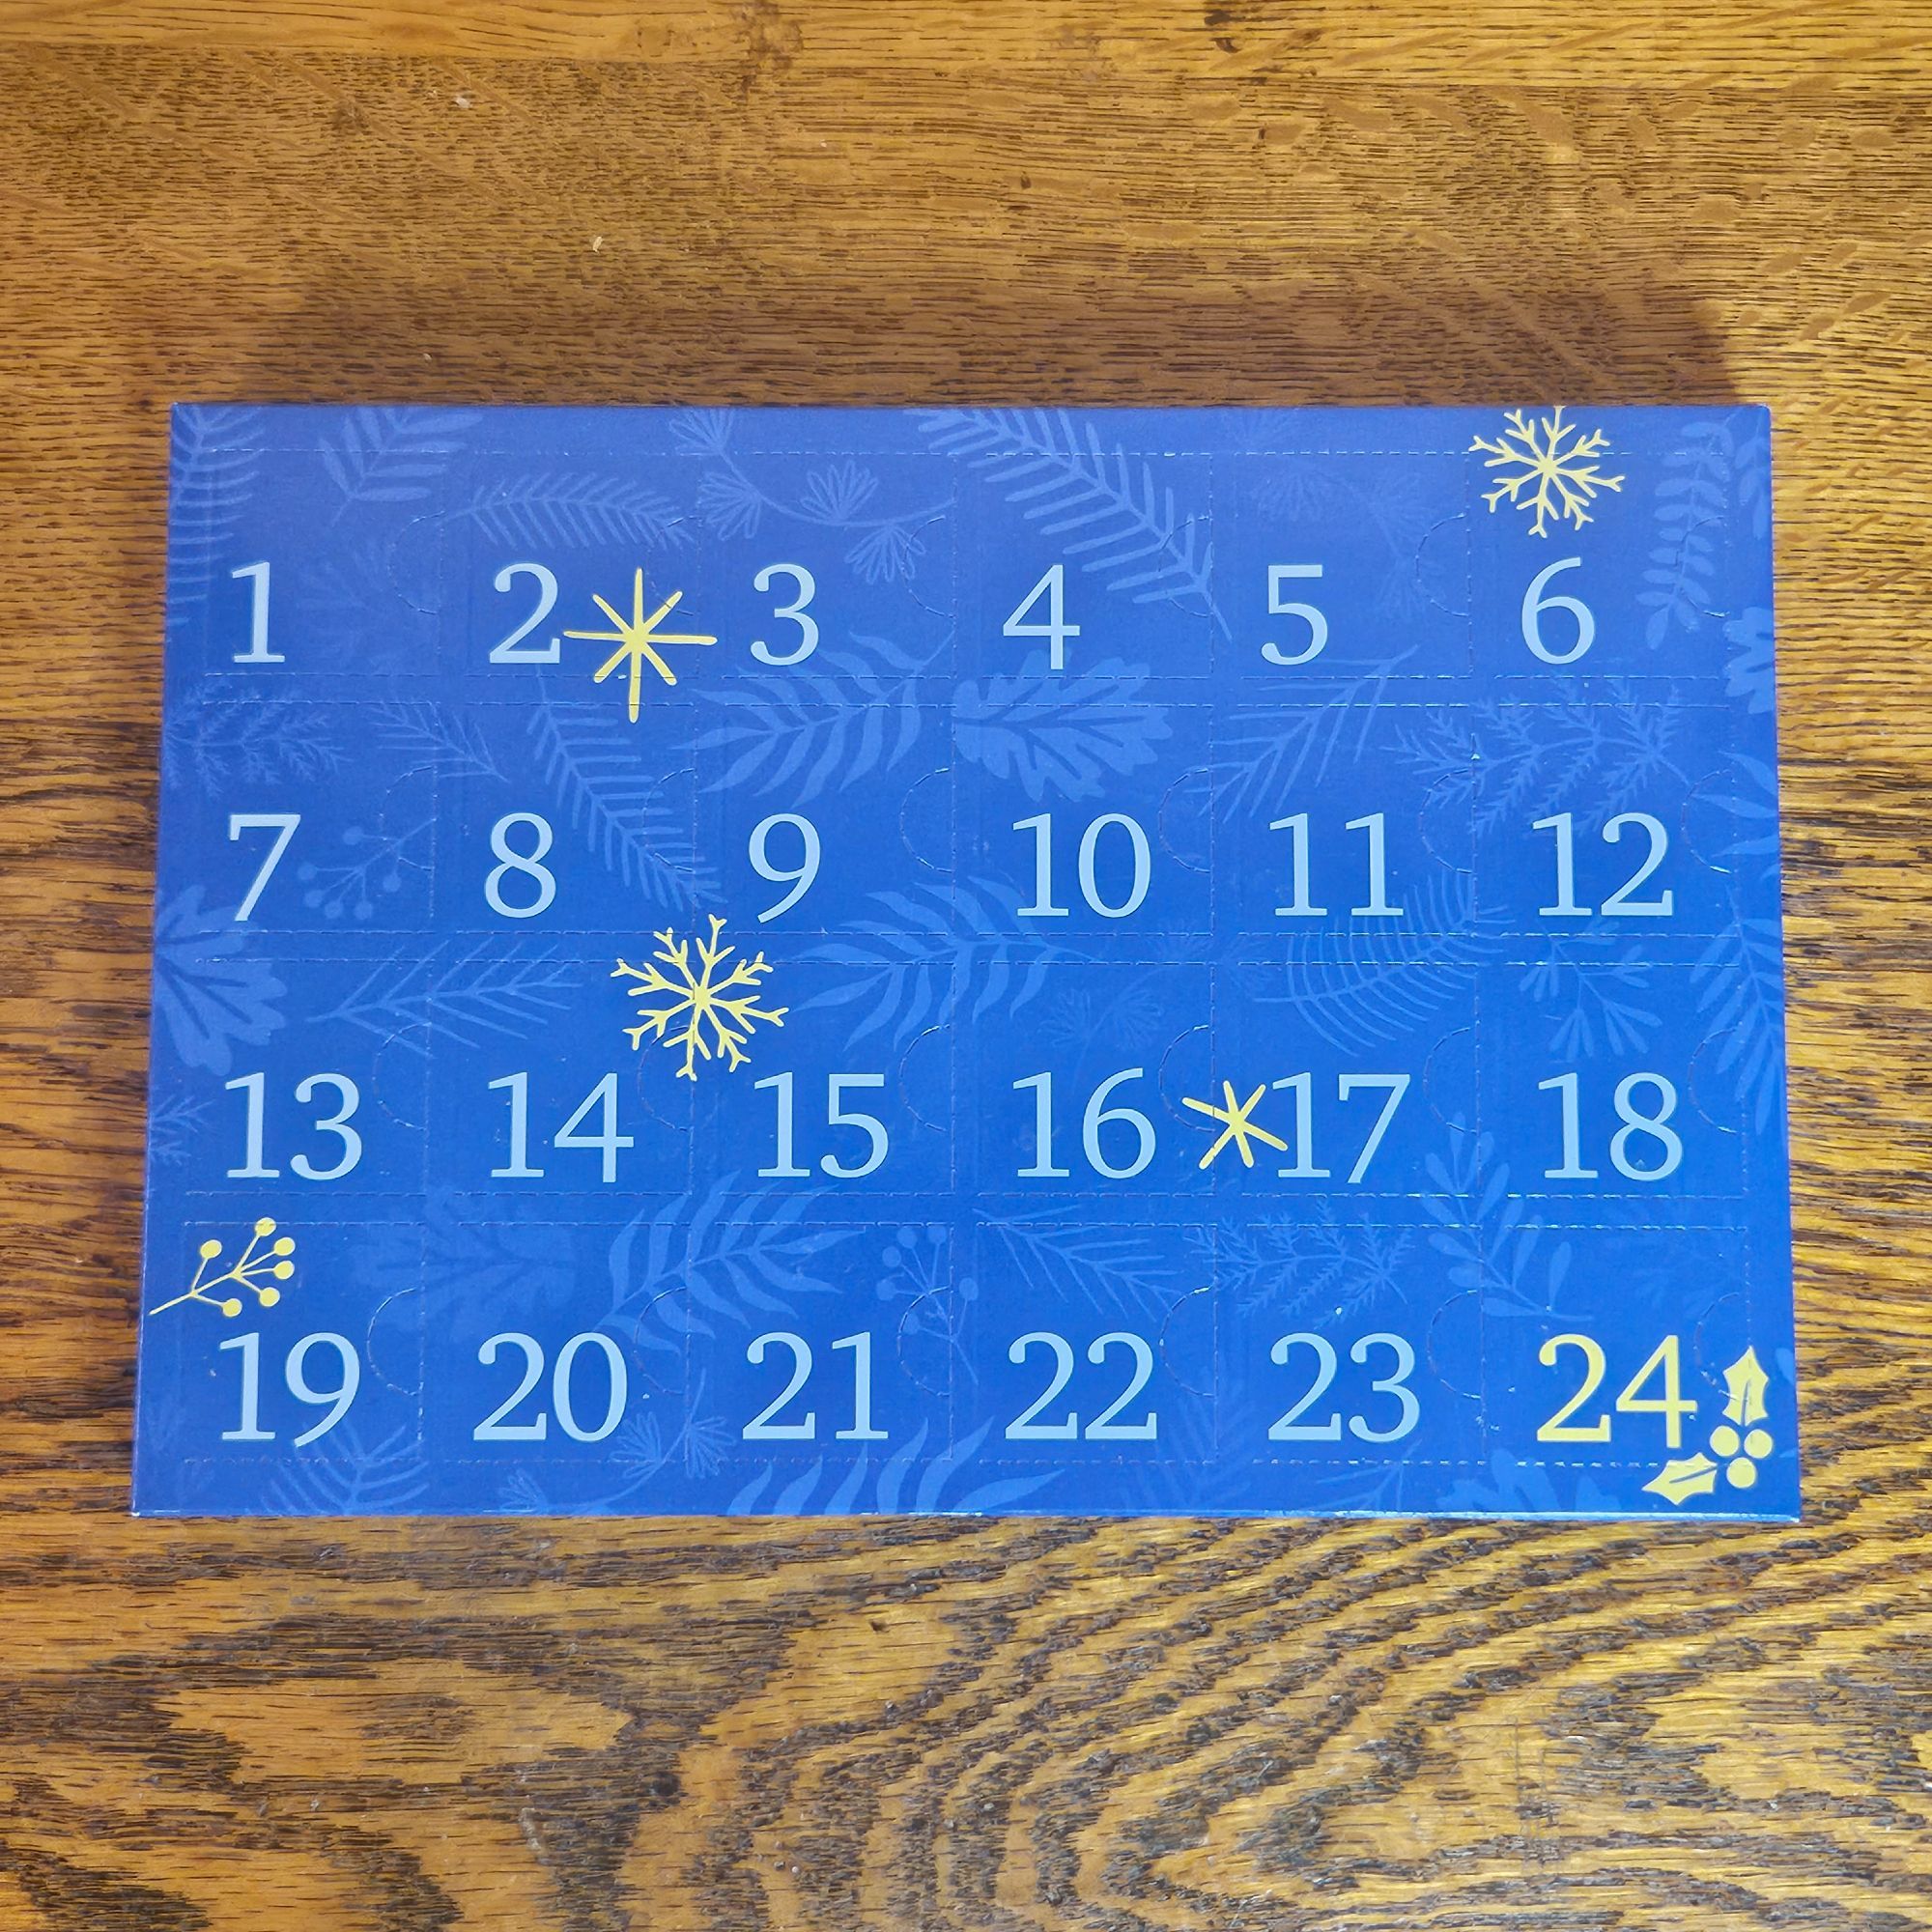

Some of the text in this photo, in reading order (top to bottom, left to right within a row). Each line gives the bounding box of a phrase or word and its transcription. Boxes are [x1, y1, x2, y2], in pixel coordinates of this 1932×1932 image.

[231, 561, 286, 664] 1
[489, 562, 561, 665] 2
[750, 563, 819, 666] 3
[1003, 564, 1081, 670] 4
[1261, 564, 1328, 666] 5
[1521, 556, 1595, 665] 6
[229, 813, 301, 922] 7
[485, 812, 556, 919] 8
[749, 812, 821, 923] 9
[1012, 812, 1151, 918] 10
[1269, 812, 1404, 916] 11
[1532, 812, 1673, 916] 12
[225, 1071, 362, 1180] 13
[489, 1071, 635, 1183] 14
[753, 1071, 889, 1179] 15
[1012, 1067, 1156, 1179] 16
[1272, 1071, 1410, 1183] 17
[1538, 1071, 1683, 1180] 18
[219, 1332, 360, 1448] 19
[473, 1332, 627, 1442] 20
[742, 1331, 889, 1439] 21
[1005, 1332, 1157, 1439] 22
[1268, 1332, 1420, 1442] 23
[1536, 1333, 1698, 1449] 24
